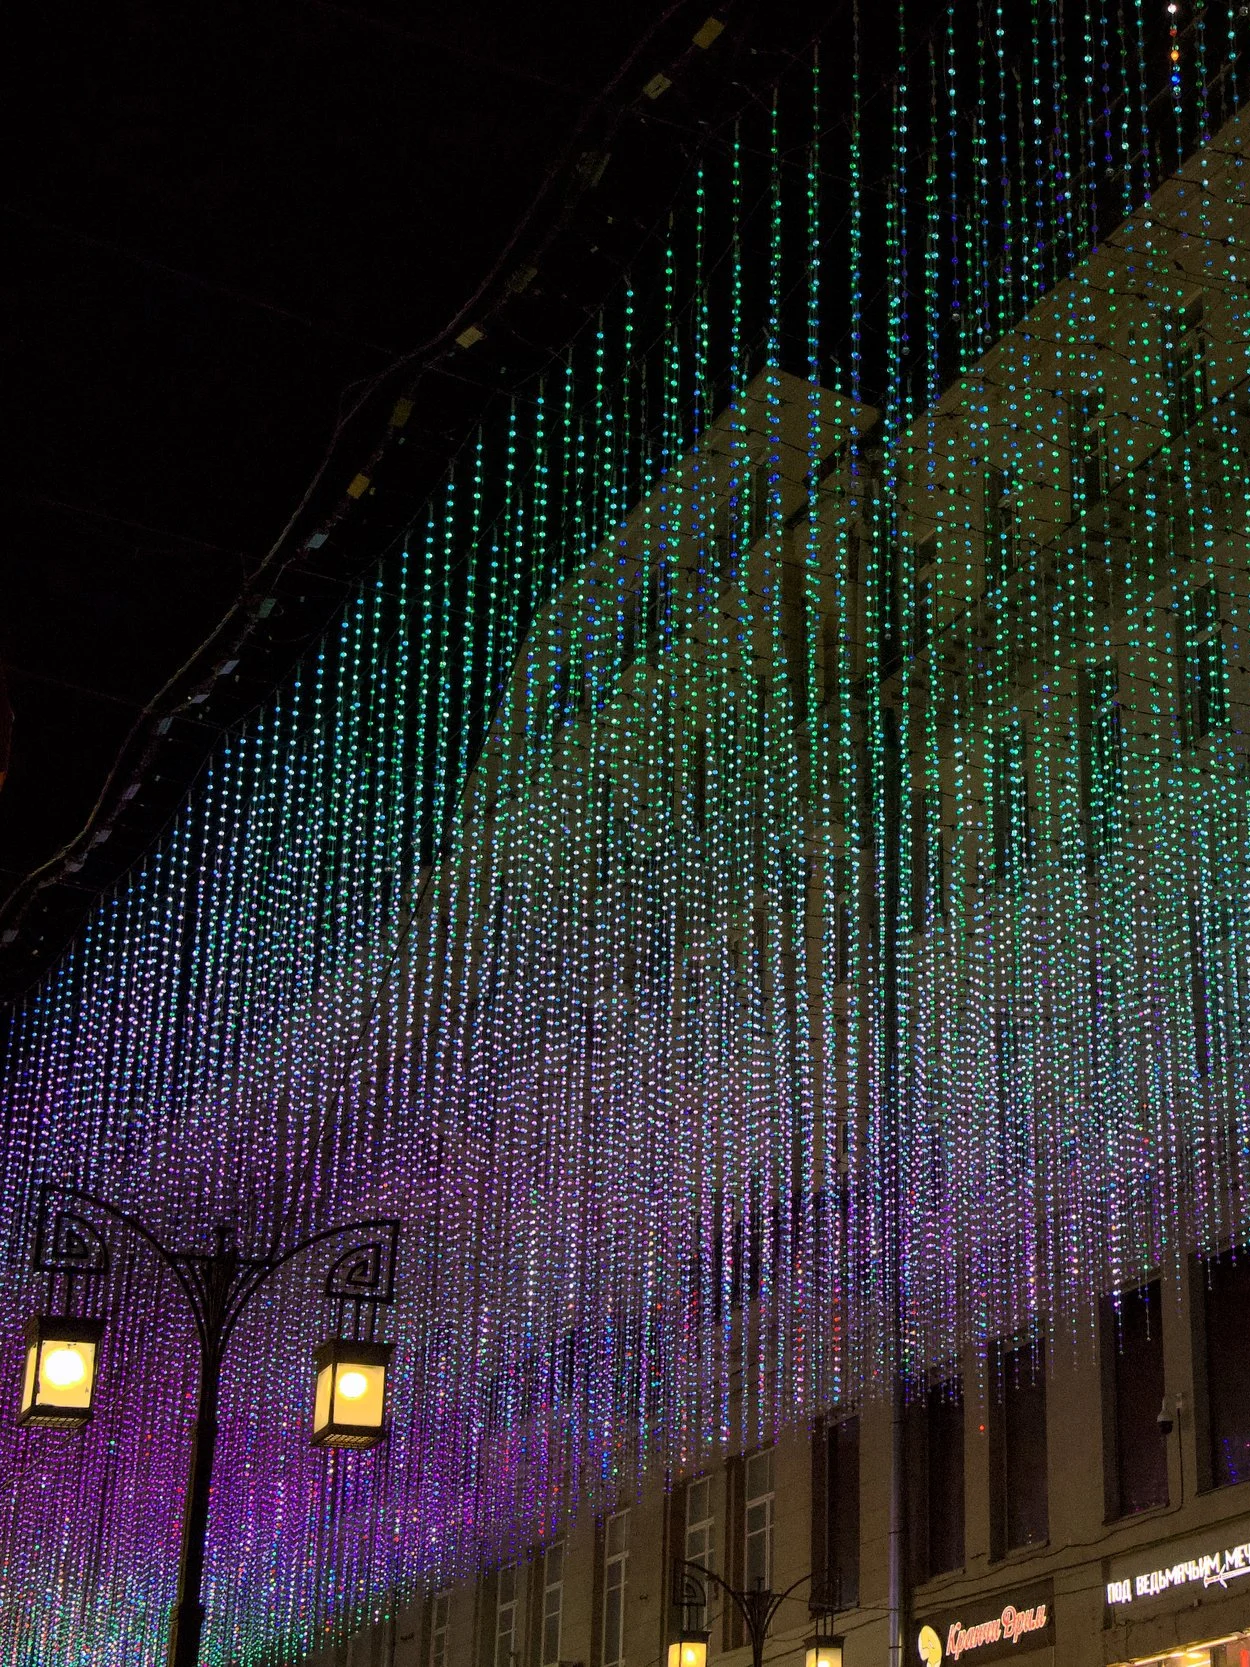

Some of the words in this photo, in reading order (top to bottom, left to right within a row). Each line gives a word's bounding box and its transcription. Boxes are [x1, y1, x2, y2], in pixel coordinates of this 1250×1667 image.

[1107, 1578, 1133, 1604] ПОД
[1136, 1552, 1221, 1596] ВЕДЬМЯЧЬИМ
[945, 1621, 1001, 1661] Кранчи
[1001, 1605, 1047, 1644] Дрим
